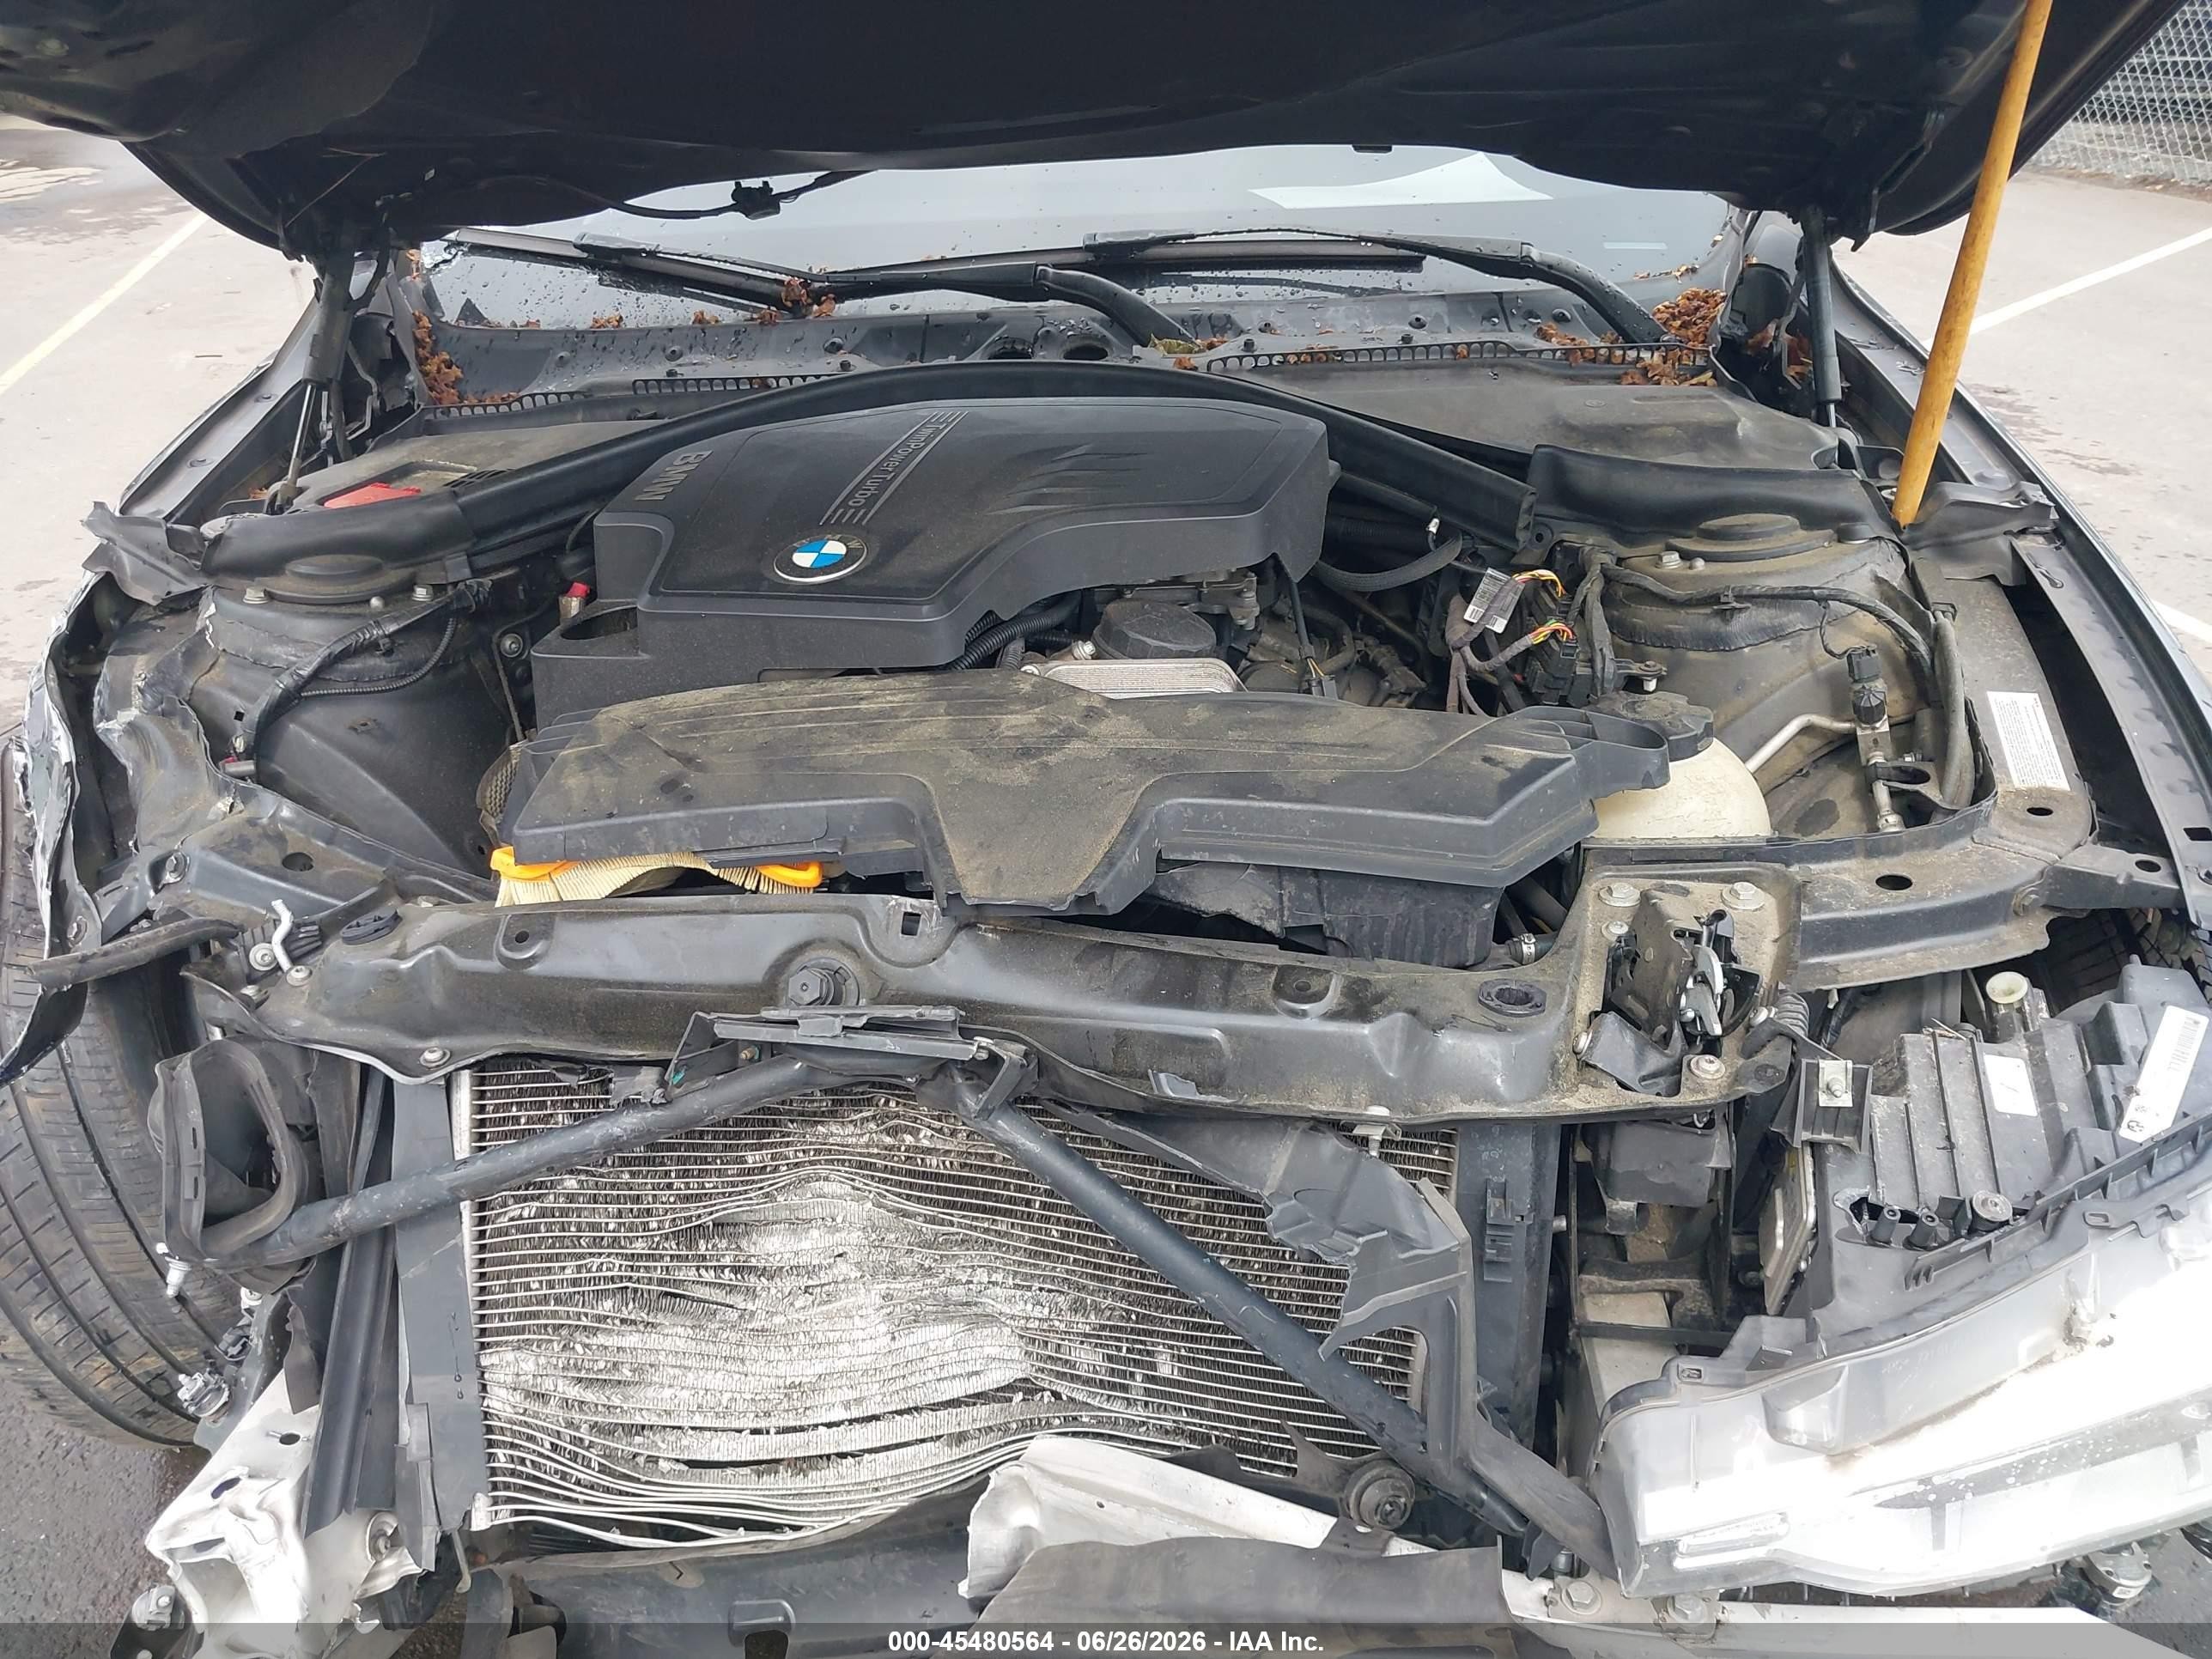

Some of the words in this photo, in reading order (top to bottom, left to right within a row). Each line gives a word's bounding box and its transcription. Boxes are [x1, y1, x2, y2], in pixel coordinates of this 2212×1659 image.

[879, 422, 947, 472] TwinPower
[633, 450, 714, 501] BMW
[848, 471, 896, 507] Turbo
